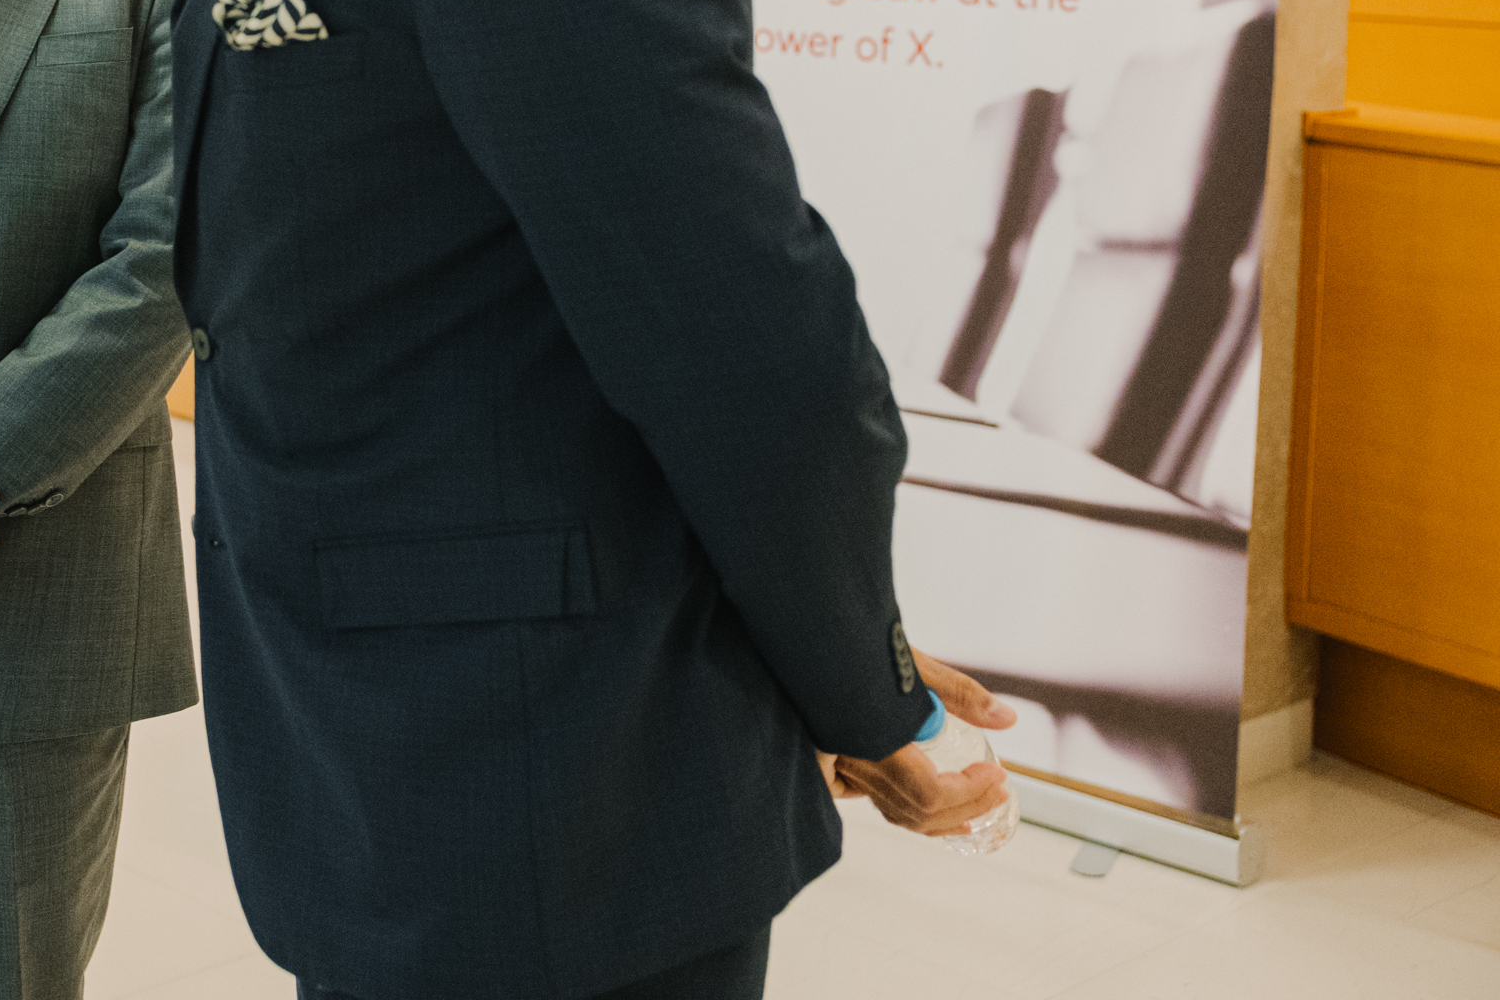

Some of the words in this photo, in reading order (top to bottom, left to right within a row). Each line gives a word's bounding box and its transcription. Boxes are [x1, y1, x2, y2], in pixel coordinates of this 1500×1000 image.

[754, 27, 843, 58] ower
[856, 25, 896, 63] of
[906, 29, 945, 69] X.
